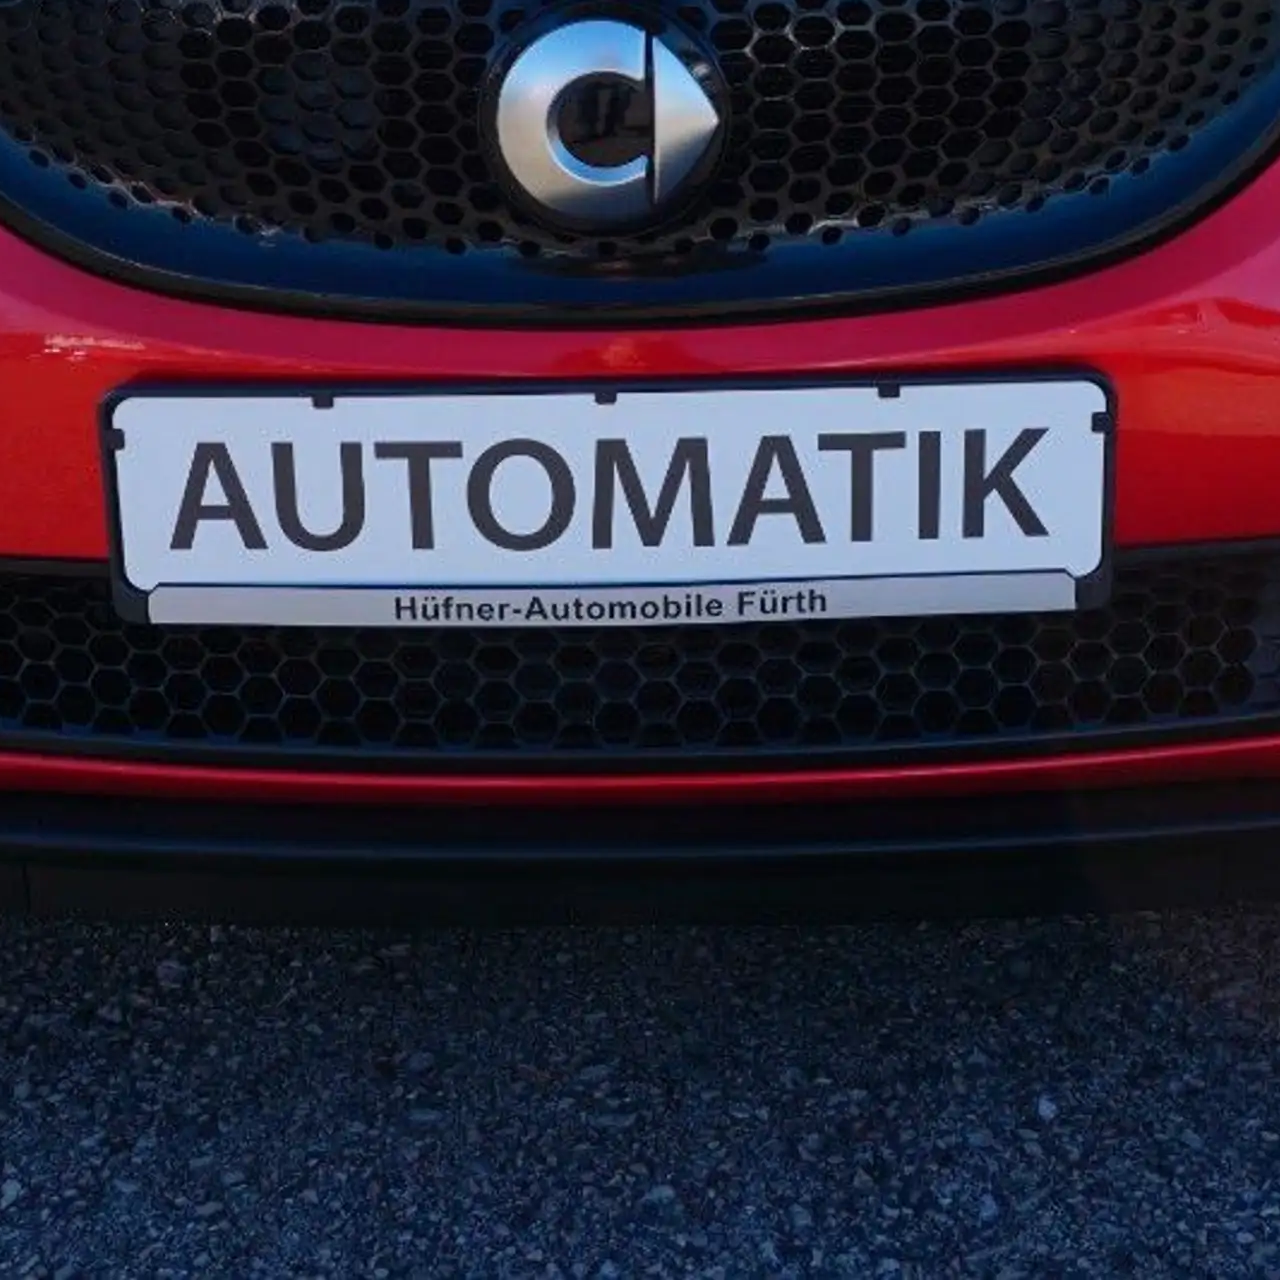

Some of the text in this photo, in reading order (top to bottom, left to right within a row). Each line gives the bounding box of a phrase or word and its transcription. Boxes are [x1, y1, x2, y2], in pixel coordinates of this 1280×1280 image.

[169, 426, 1050, 553] AUTOMATIK
[394, 588, 828, 623] Hüfner-Automobile Fürth
